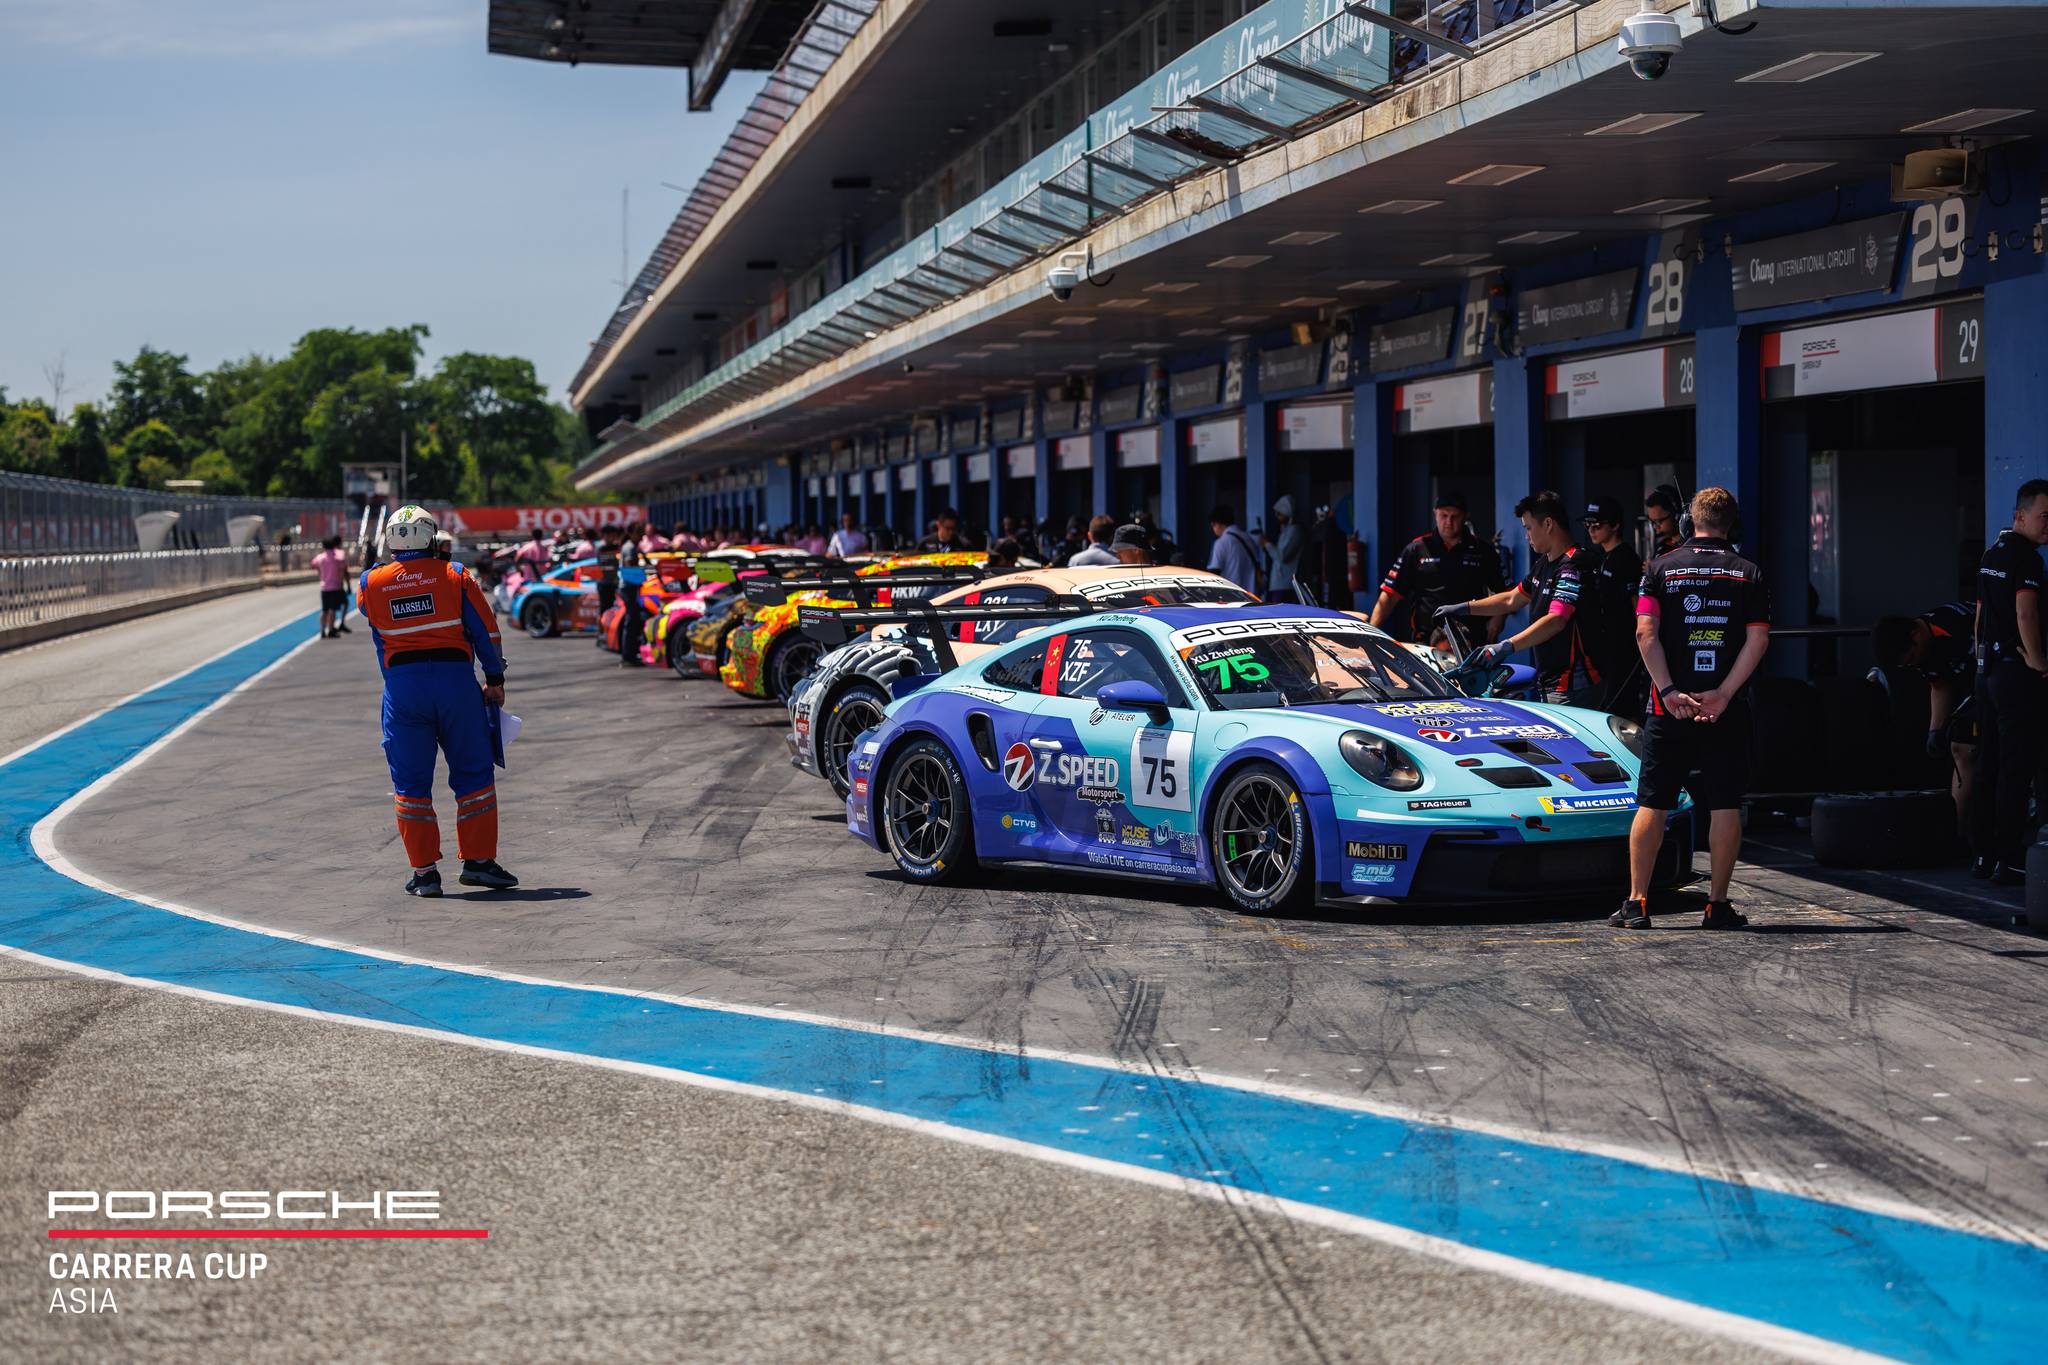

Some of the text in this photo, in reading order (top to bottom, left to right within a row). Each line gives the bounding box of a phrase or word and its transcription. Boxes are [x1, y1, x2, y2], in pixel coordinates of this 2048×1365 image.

[1911, 197, 1966, 283] 29
[1750, 248, 1856, 284] Chang INTERNATIONAL CIRCUIT
[1648, 259, 1684, 327] 28
[1463, 299, 1489, 357] 27
[1802, 339, 1836, 351] PORSCHE
[1959, 319, 1978, 363] 29
[1680, 358, 1694, 393] 28
[396, 571, 423, 582] Chang
[419, 577, 438, 585] CIRCUIT
[1665, 567, 1744, 578] PORSCHE
[1665, 579, 1695, 587] CARRERA
[891, 587, 921, 598] HKW
[392, 600, 432, 615] MARSHAL
[801, 609, 834, 617] PORSCHE
[1183, 621, 1389, 643] PORSCHE
[1689, 630, 1724, 641] MUSE
[1068, 639, 1092, 659] 75
[1191, 646, 1256, 666] XU Zhefeng
[1060, 662, 1091, 681] XZF
[1197, 653, 1270, 690] 75
[1111, 713, 1136, 722] ATELIER
[1456, 725, 1556, 738] Z.SPEED
[1037, 752, 1120, 787] Z.SPEED
[1142, 756, 1177, 798] 75
[1082, 788, 1118, 799] Motorsport
[1574, 796, 1635, 809] MICHELIN
[1013, 819, 1037, 829] CTVS
[1122, 825, 1150, 839] MUSE
[1293, 812, 1303, 866] MICHELIN
[1349, 842, 1386, 859] Mobil
[1088, 852, 1197, 875] Watch LIVE on carreracupasia.com
